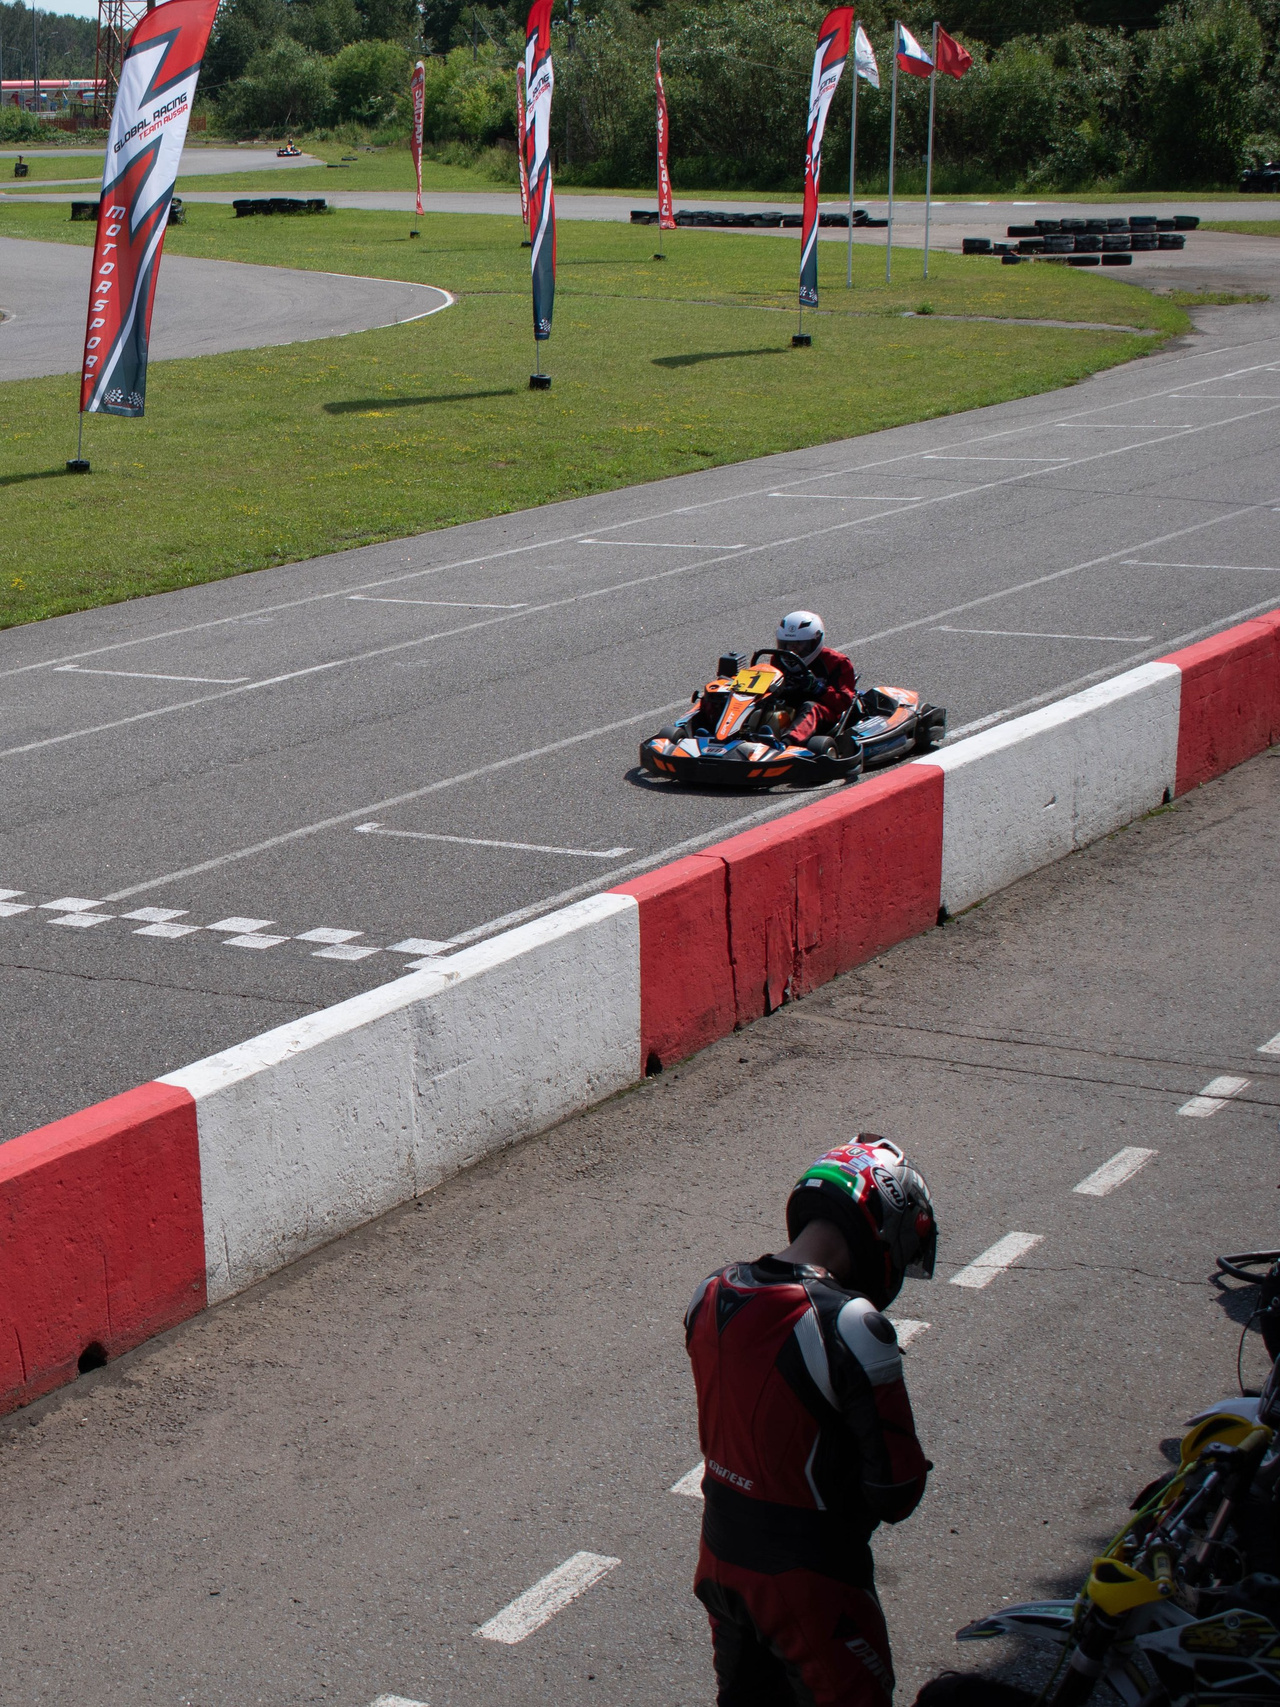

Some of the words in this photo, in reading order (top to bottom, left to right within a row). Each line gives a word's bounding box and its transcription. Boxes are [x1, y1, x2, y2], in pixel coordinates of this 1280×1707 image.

[114, 118, 151, 154] GLOBAL
[153, 91, 187, 121] RACING
[138, 120, 163, 141] TEAM
[163, 103, 188, 125] RUSSIA
[747, 674, 761, 689] 1
[875, 1171, 905, 1205] Arai
